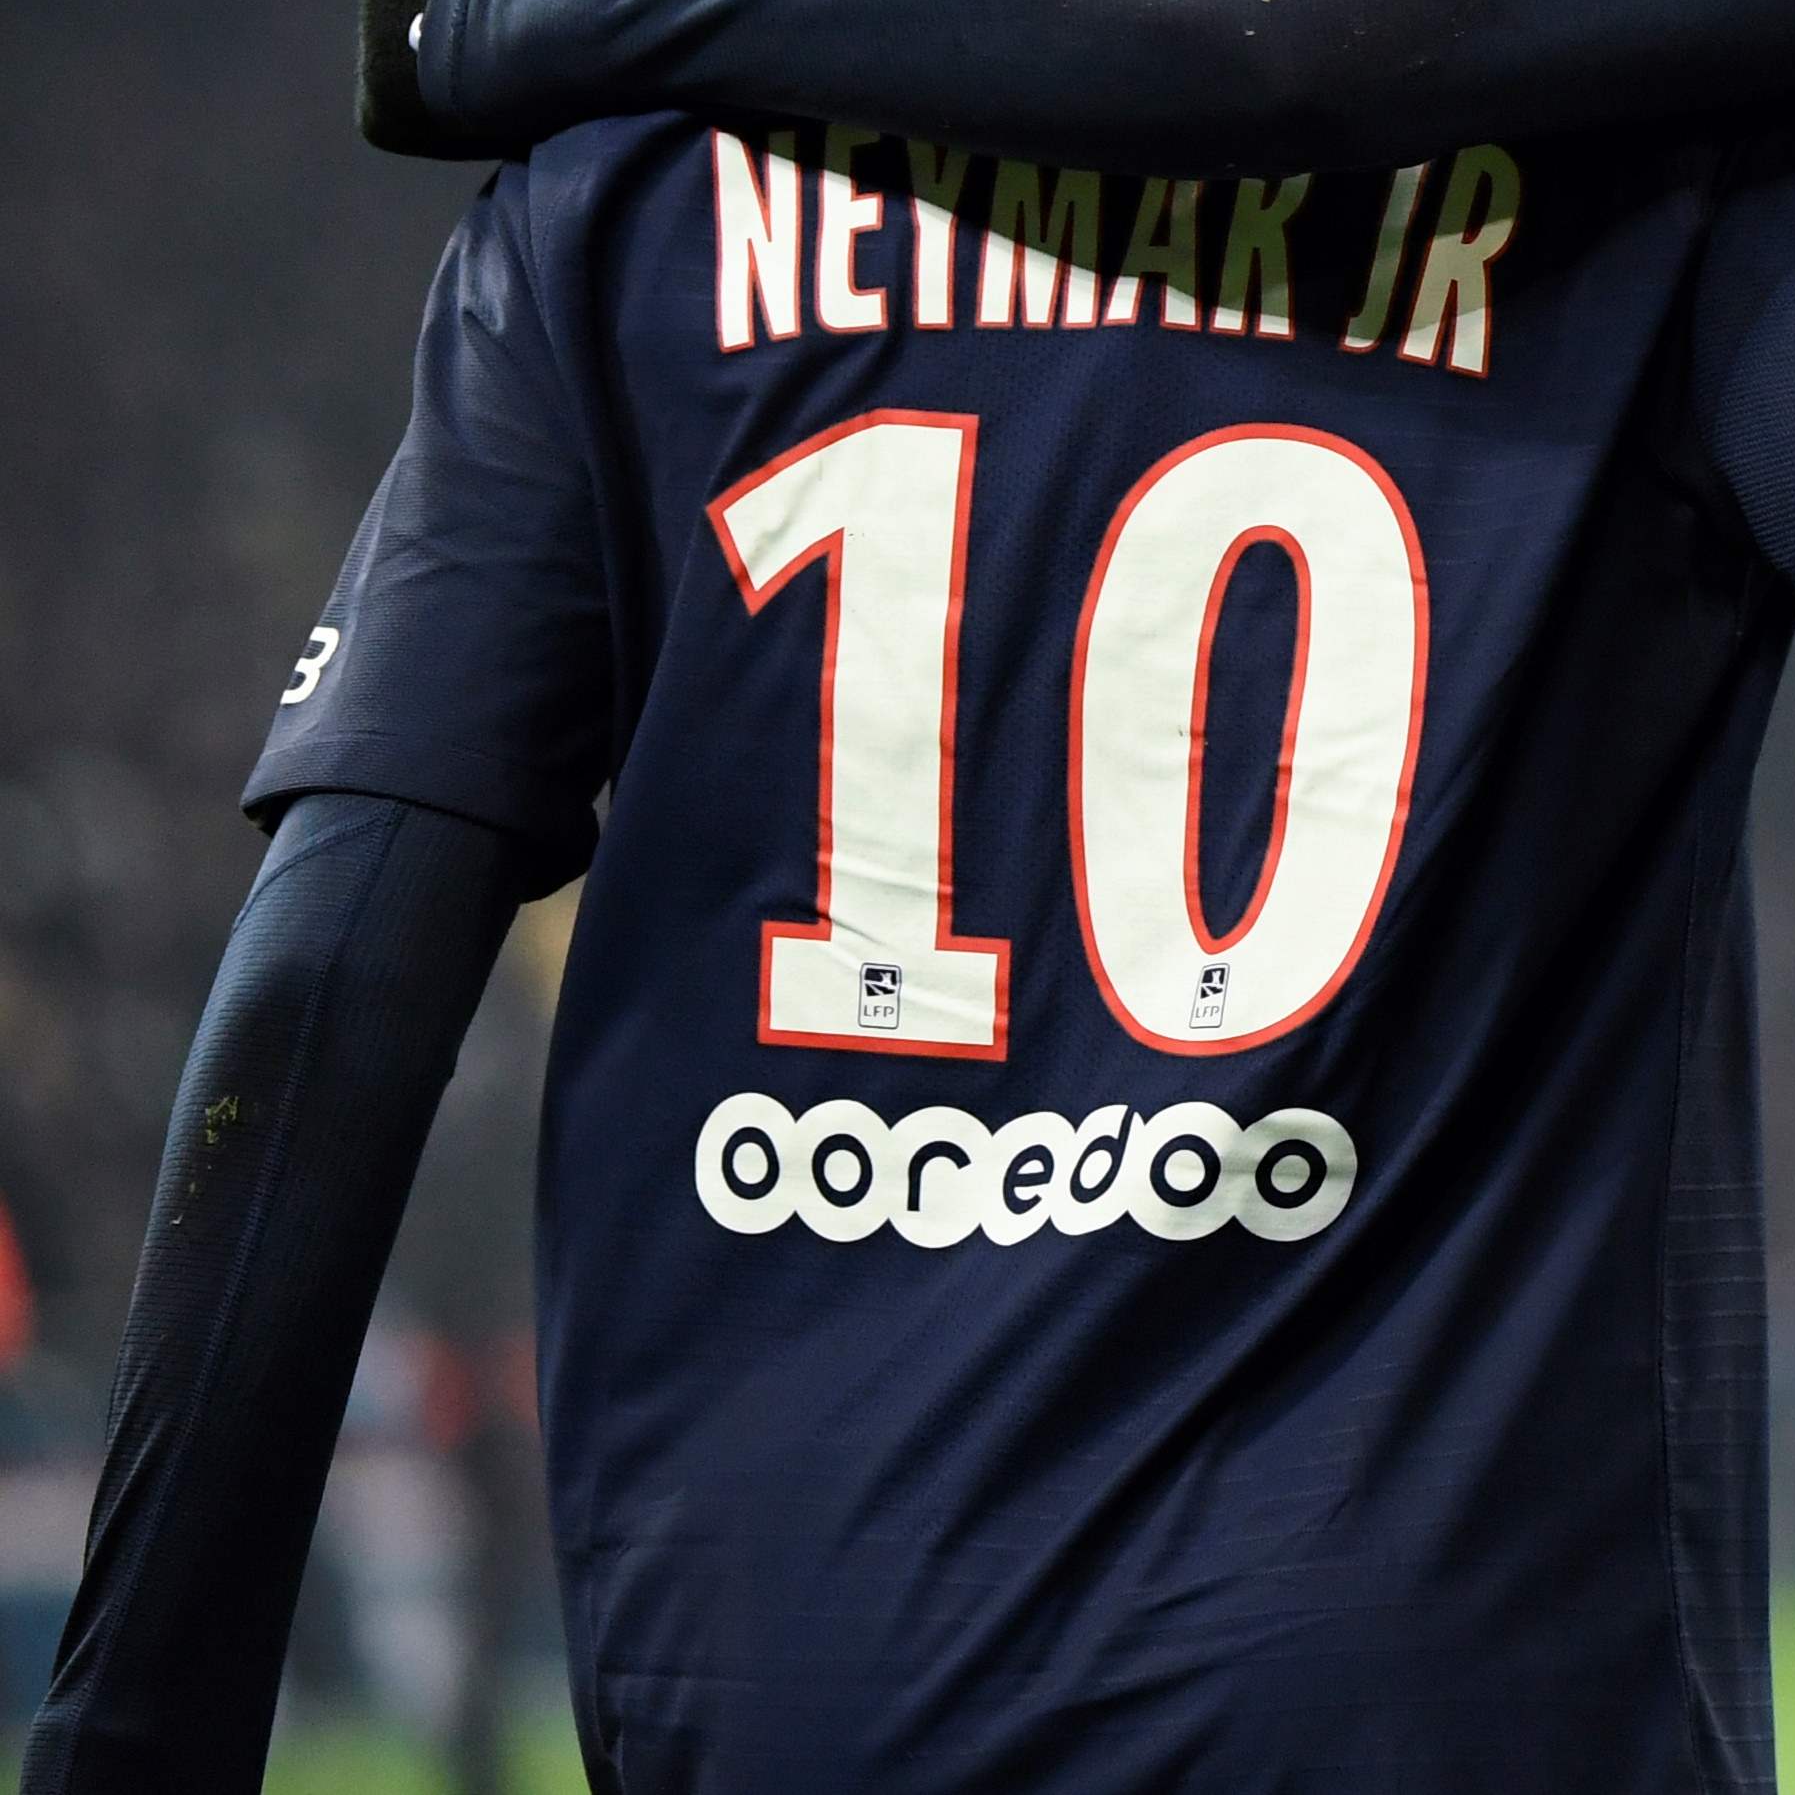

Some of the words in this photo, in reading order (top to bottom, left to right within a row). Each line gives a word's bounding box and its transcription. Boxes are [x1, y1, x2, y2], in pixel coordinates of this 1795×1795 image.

[713, 124, 1294, 353] NEYMAR
[1339, 142, 1523, 378] JR
[706, 408, 1431, 1062] 10
[863, 1005, 895, 1018] LFP
[1195, 1005, 1220, 1018] LFP
[695, 1092, 1358, 1249] ooredoo
